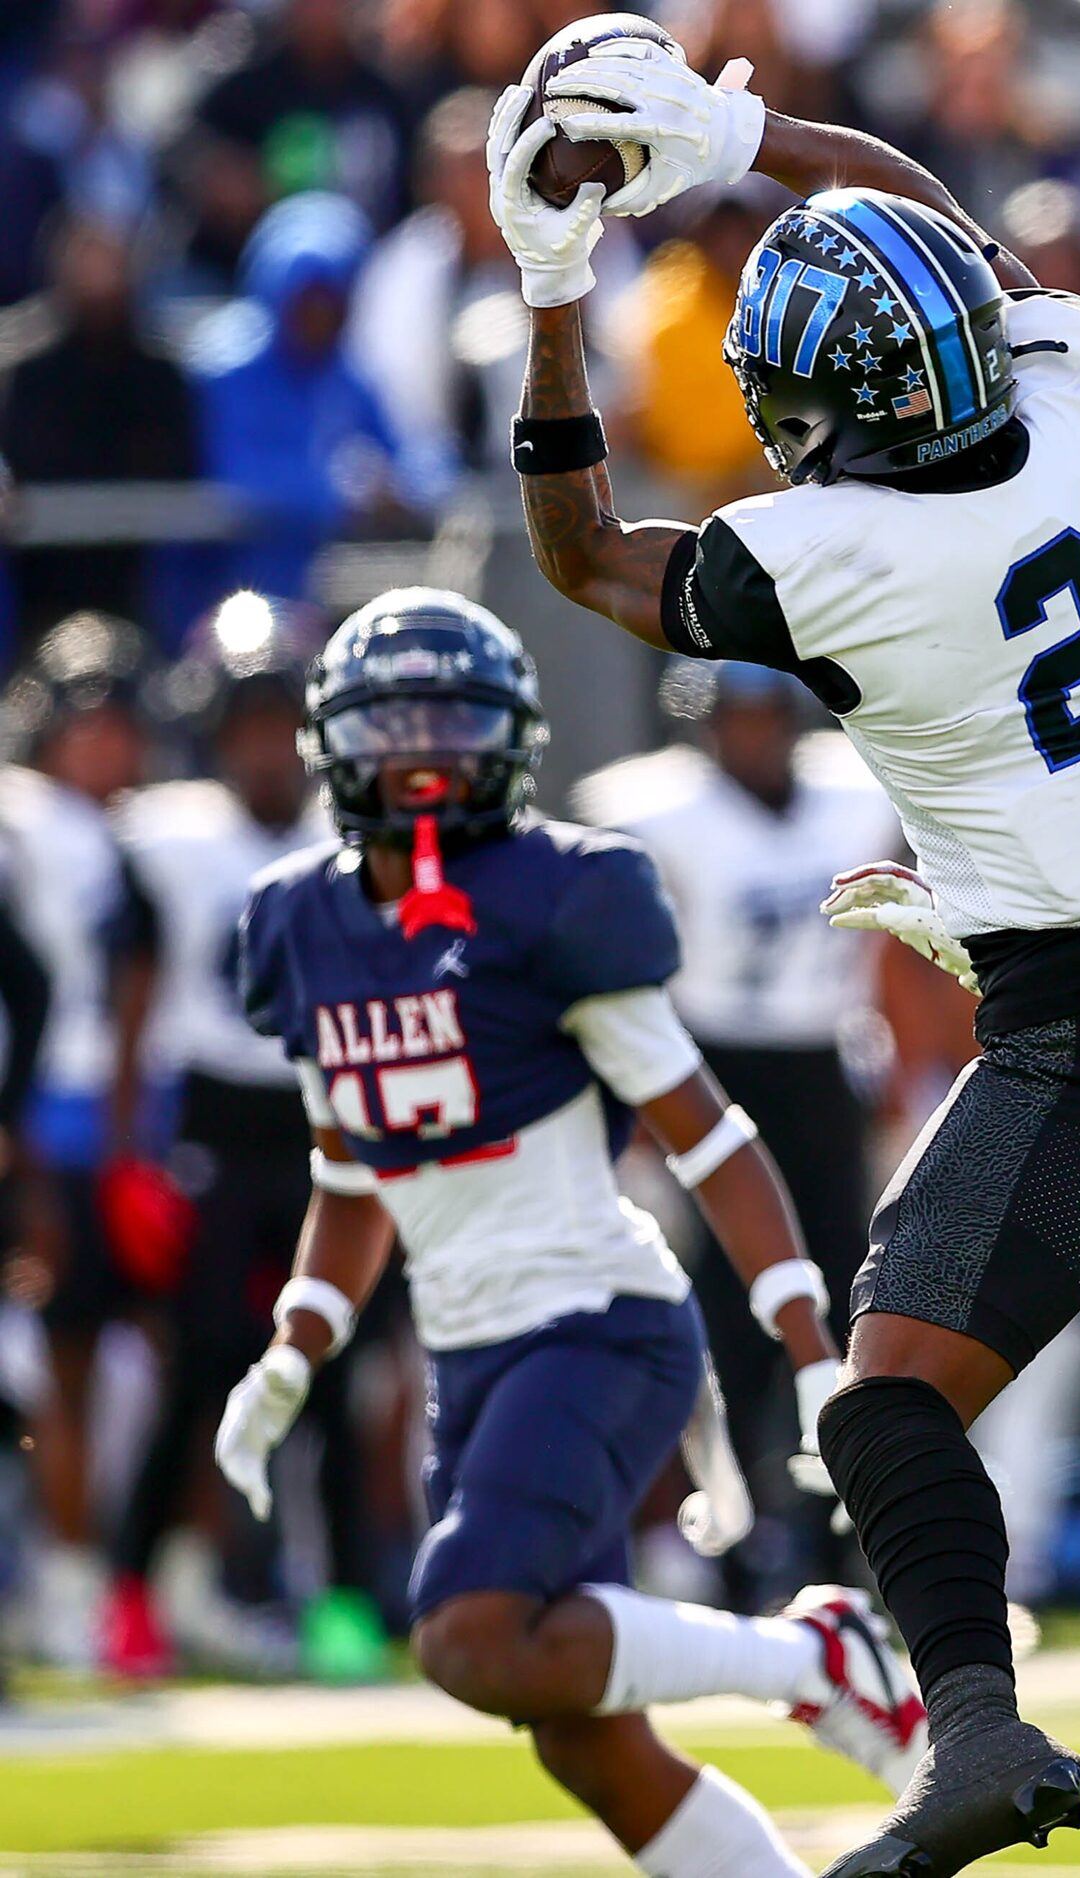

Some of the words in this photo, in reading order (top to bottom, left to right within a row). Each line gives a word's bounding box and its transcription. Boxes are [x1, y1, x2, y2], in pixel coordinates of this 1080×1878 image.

[740, 247, 850, 379] 817
[986, 348, 1001, 383] 2
[917, 403, 1009, 464] PANTHERS
[316, 986, 469, 1070] ALLEN
